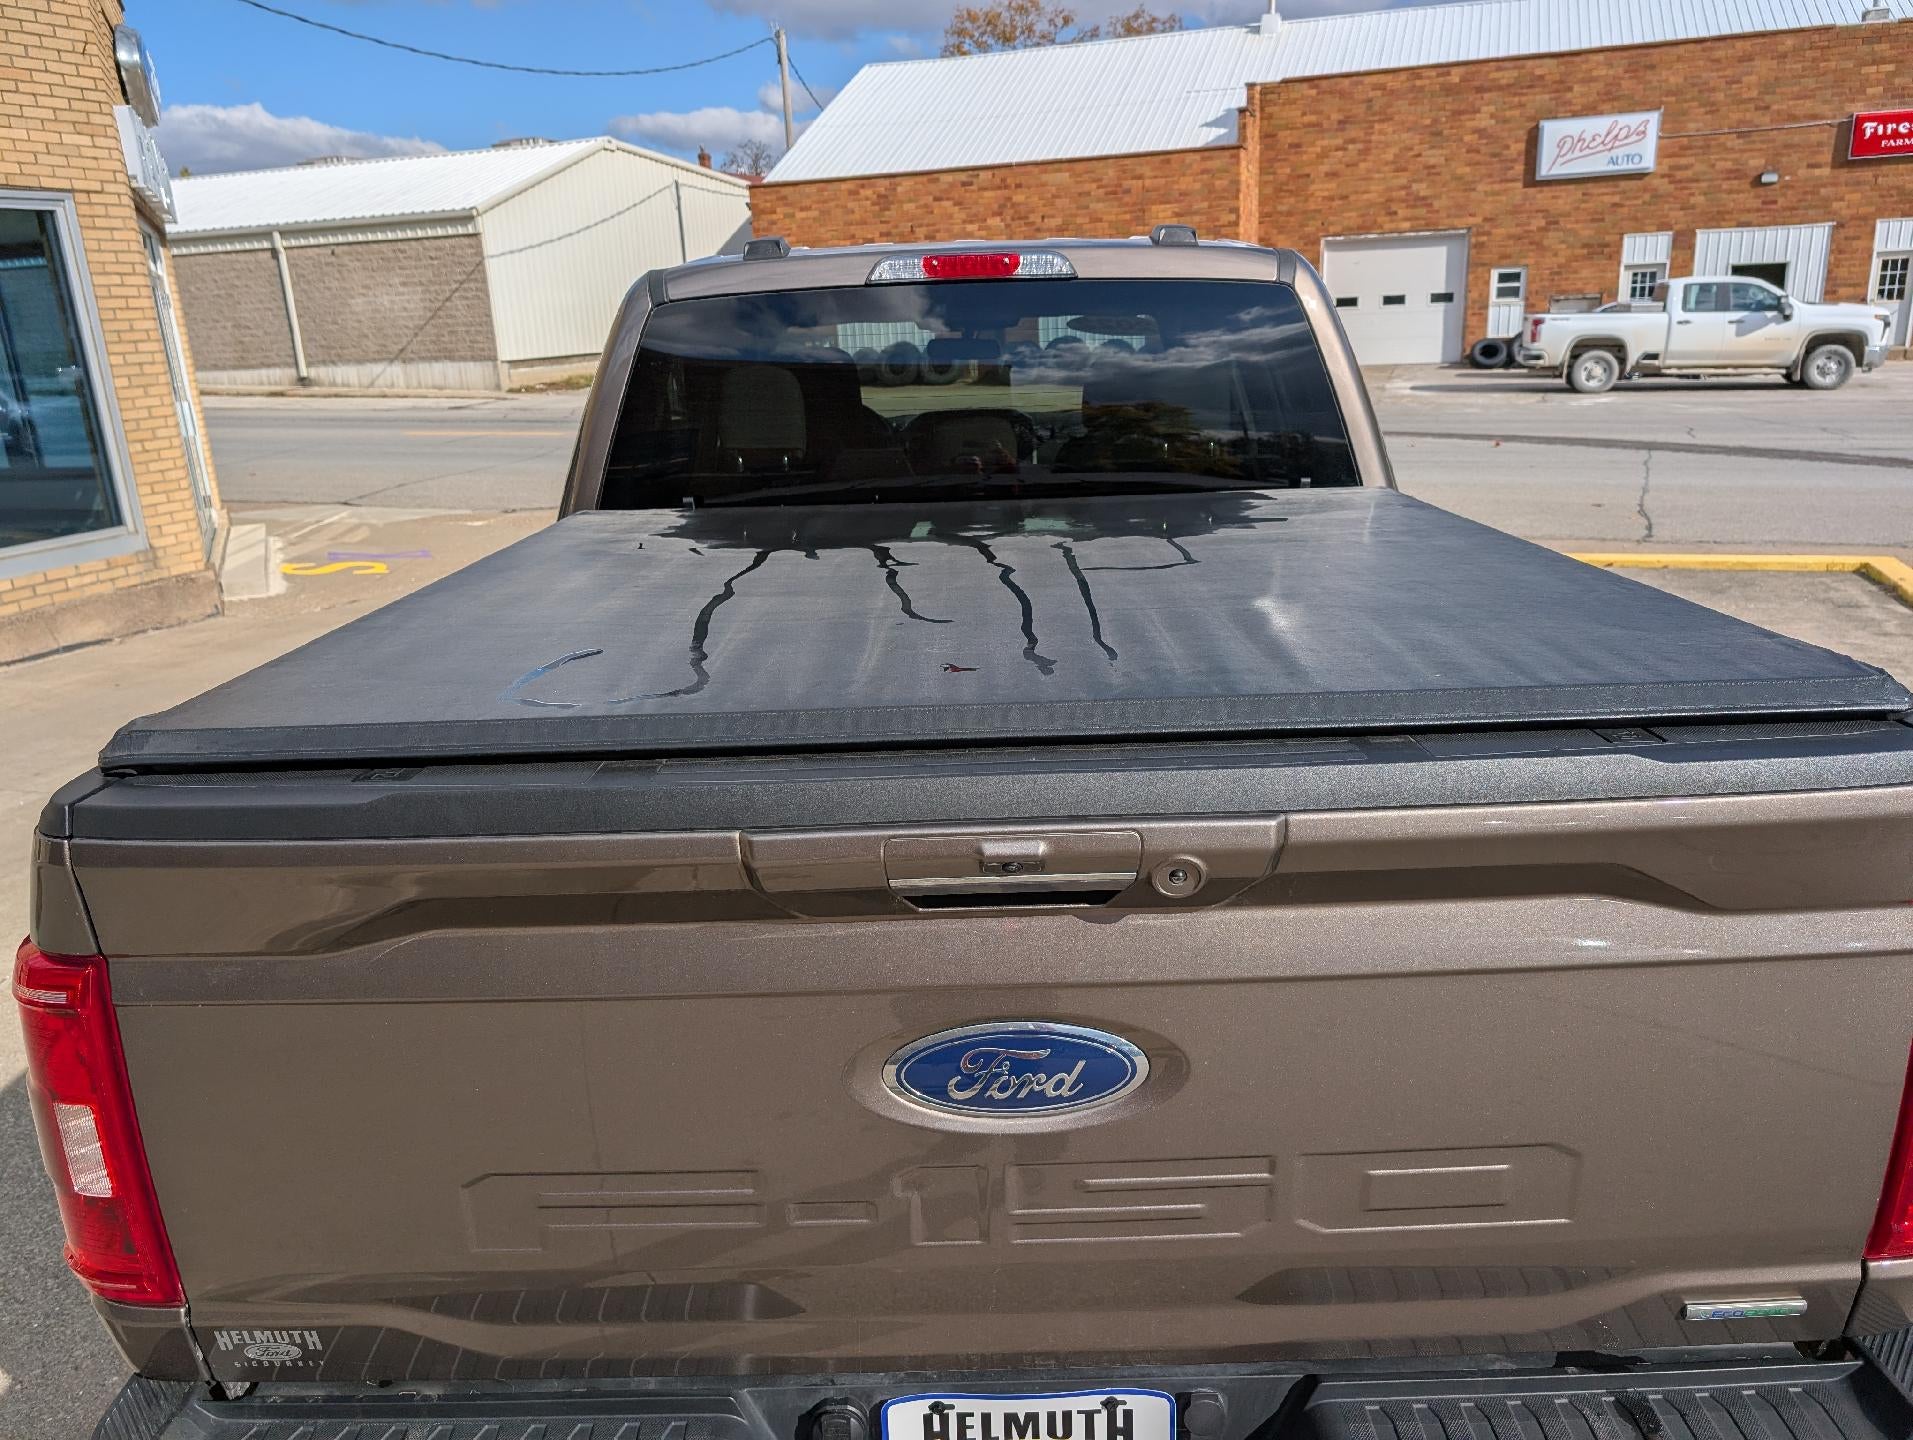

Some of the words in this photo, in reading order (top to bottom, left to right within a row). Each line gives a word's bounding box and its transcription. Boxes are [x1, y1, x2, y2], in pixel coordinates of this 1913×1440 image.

[1861, 121, 1913, 140] Fire
[1547, 119, 1650, 173] Phelps
[1606, 153, 1643, 167] AUTO
[947, 1046, 1085, 1100] Ford
[213, 1330, 323, 1351] HELMUTH
[254, 1346, 293, 1358] Ford
[922, 1407, 1134, 1440] HELMUTH
